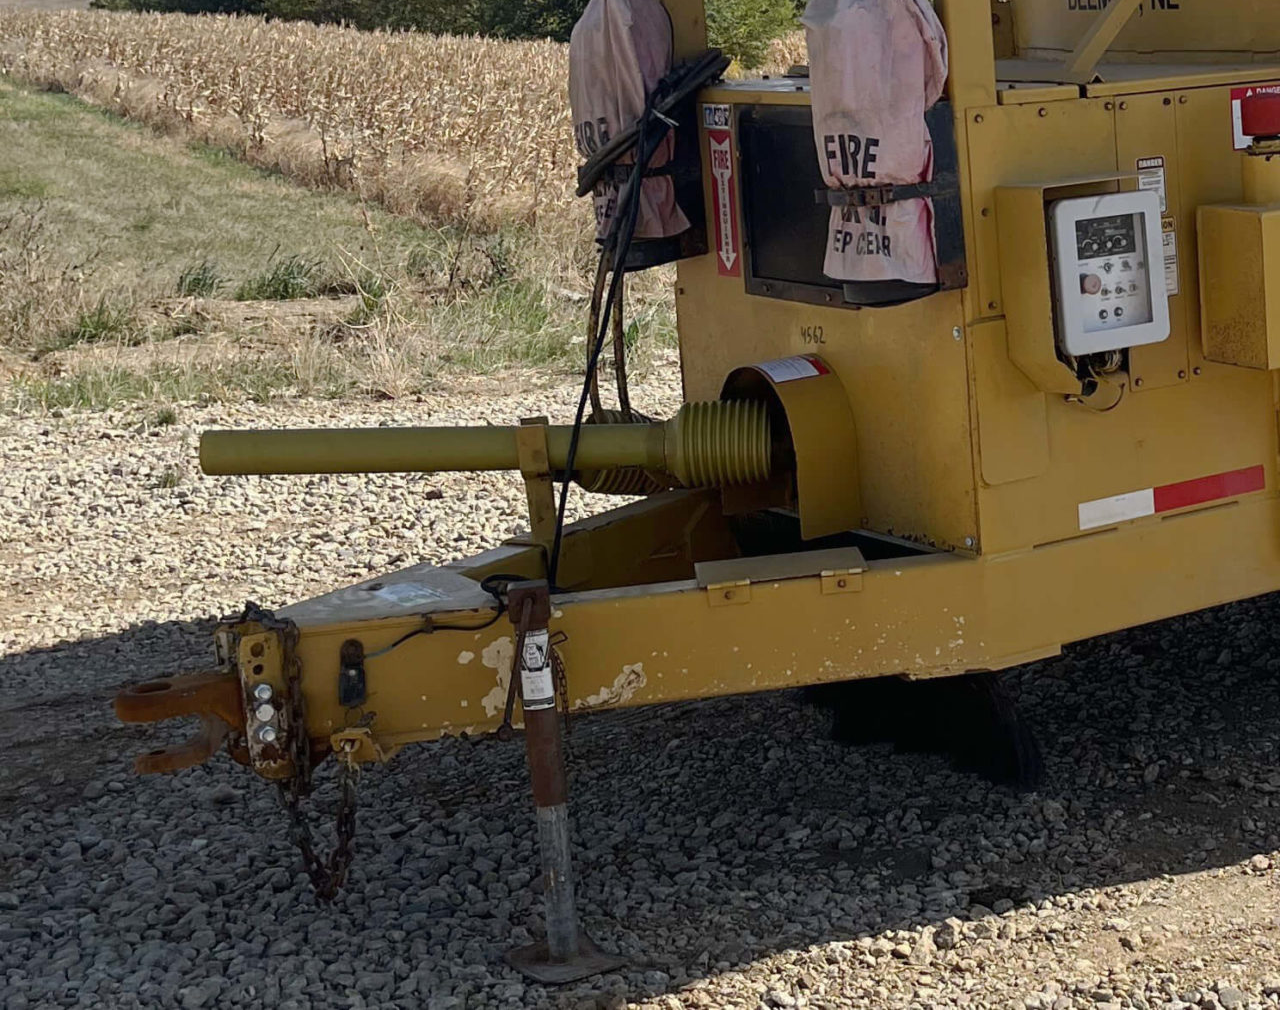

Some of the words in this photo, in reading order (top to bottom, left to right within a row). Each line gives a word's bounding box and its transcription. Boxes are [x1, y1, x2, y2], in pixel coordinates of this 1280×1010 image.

[713, 149, 729, 170] FIRE
[824, 134, 880, 179] FIRE
[856, 231, 892, 258] CEAR
[800, 326, 826, 344] 4562
